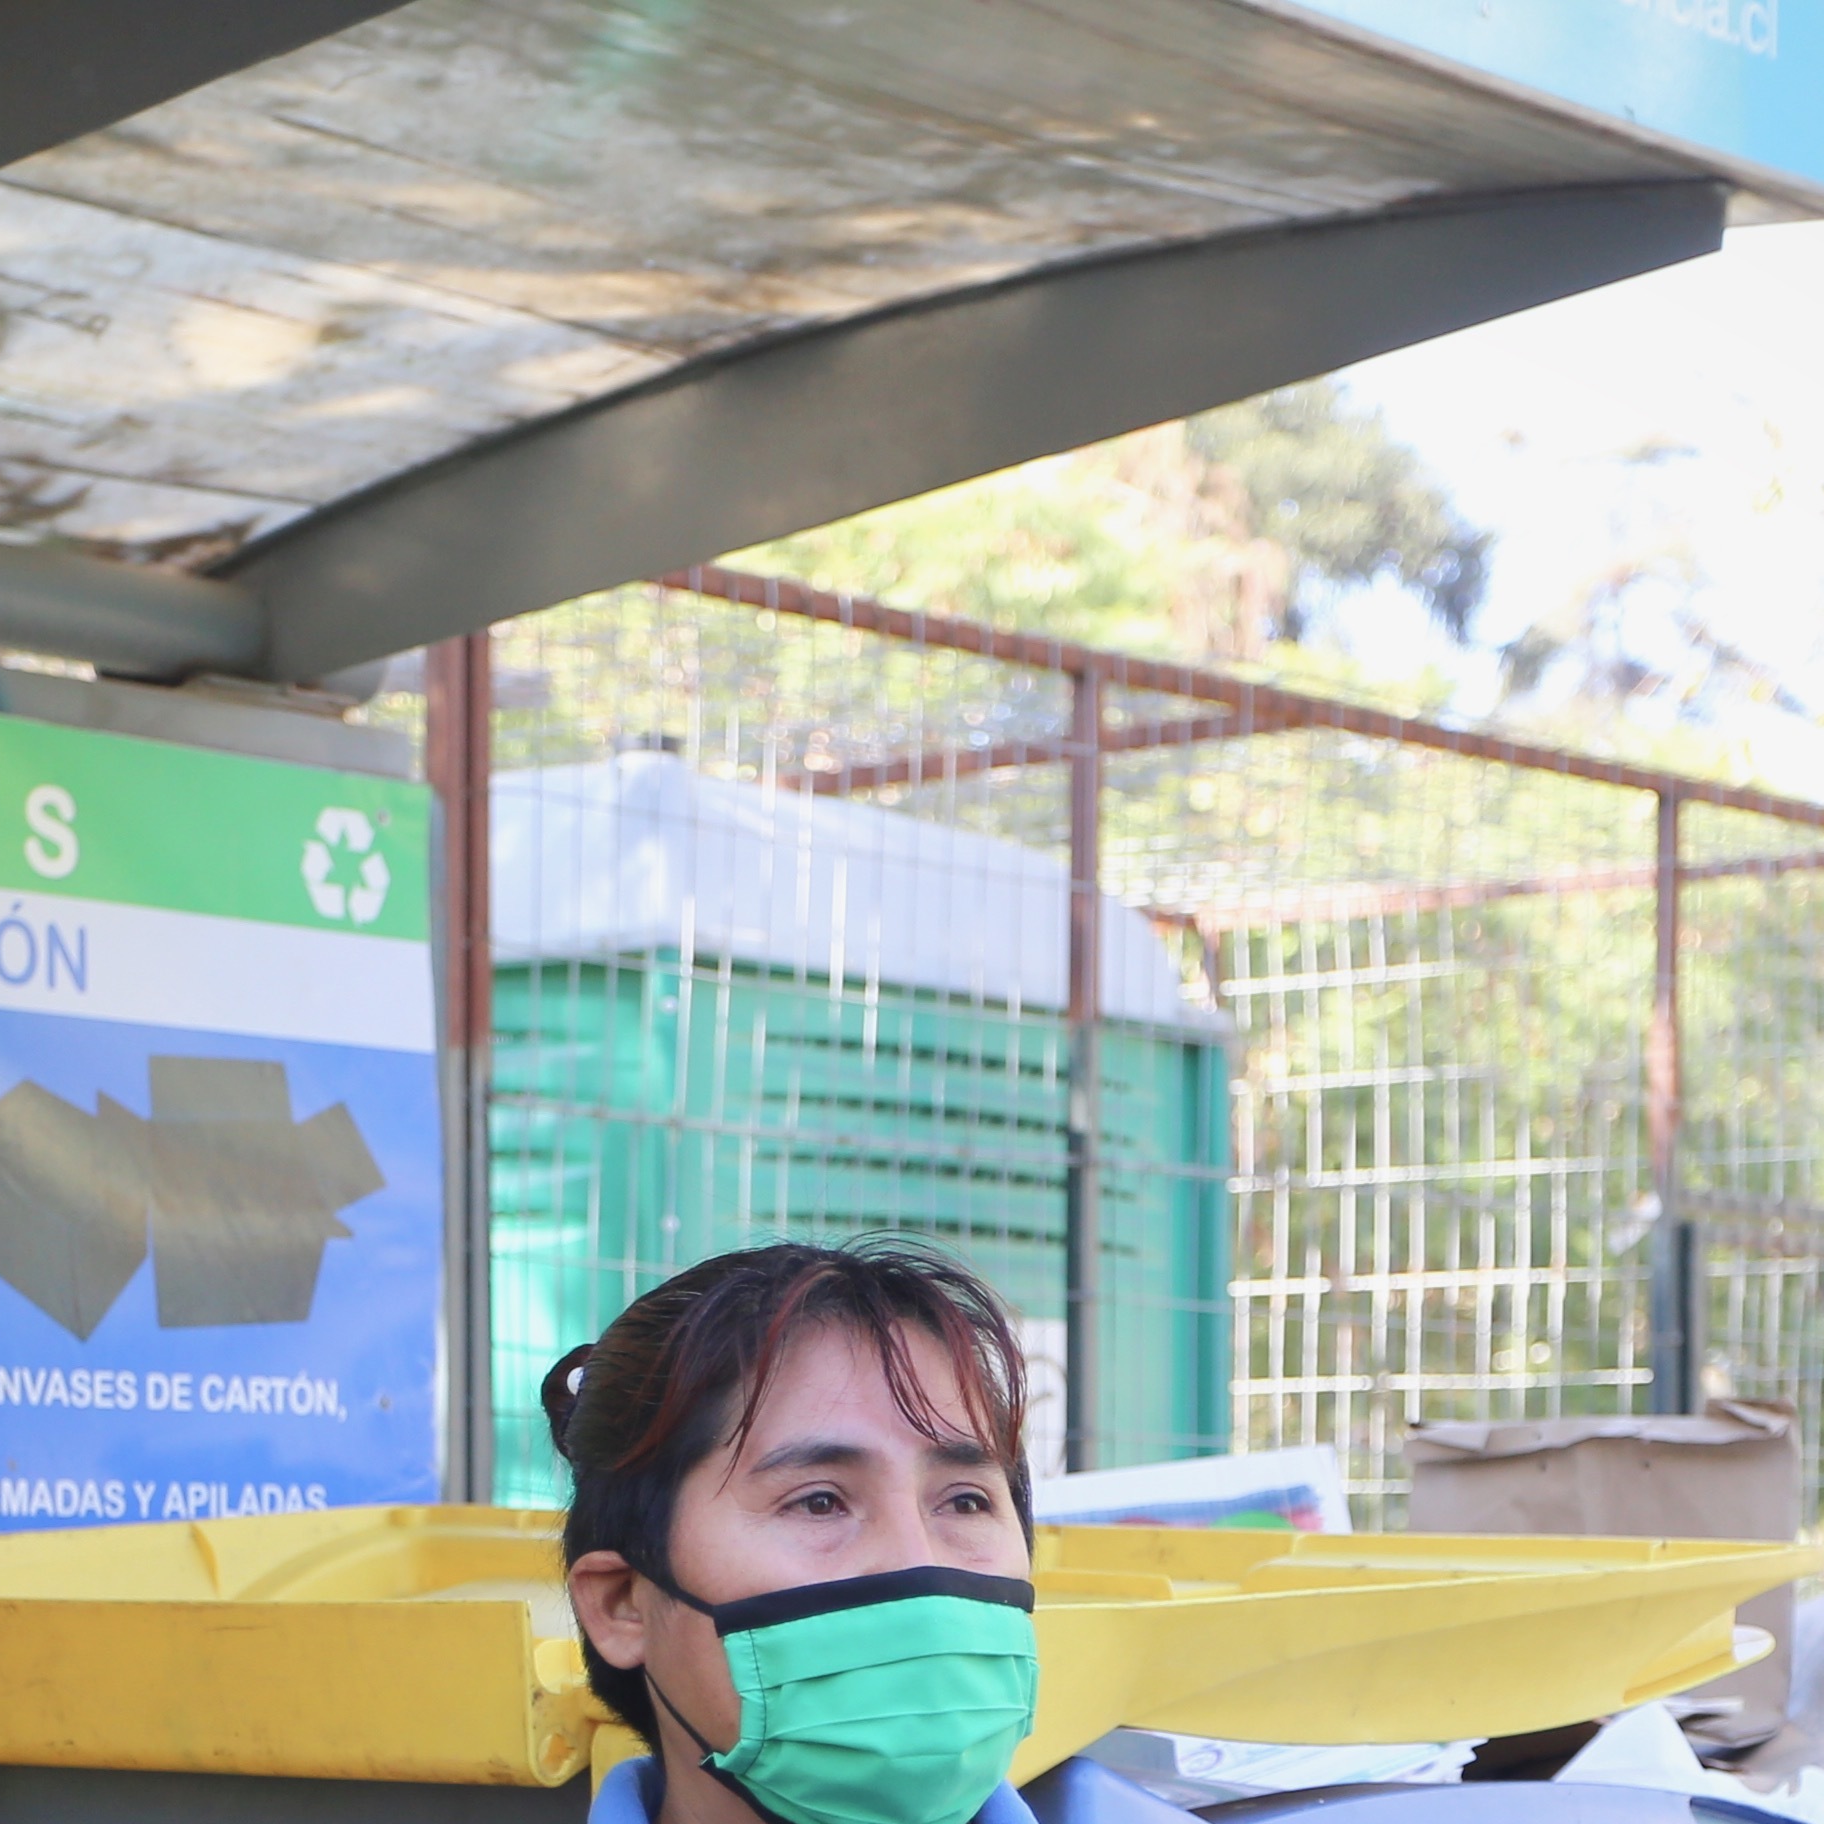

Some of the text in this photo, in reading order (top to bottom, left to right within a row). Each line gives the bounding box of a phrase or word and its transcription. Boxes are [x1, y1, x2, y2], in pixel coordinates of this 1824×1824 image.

[147, 1371, 193, 1413] DE
[199, 1374, 349, 1423] CARTÓN,
[132, 1480, 157, 1519] Y
[161, 1480, 328, 1521] APILADAS
